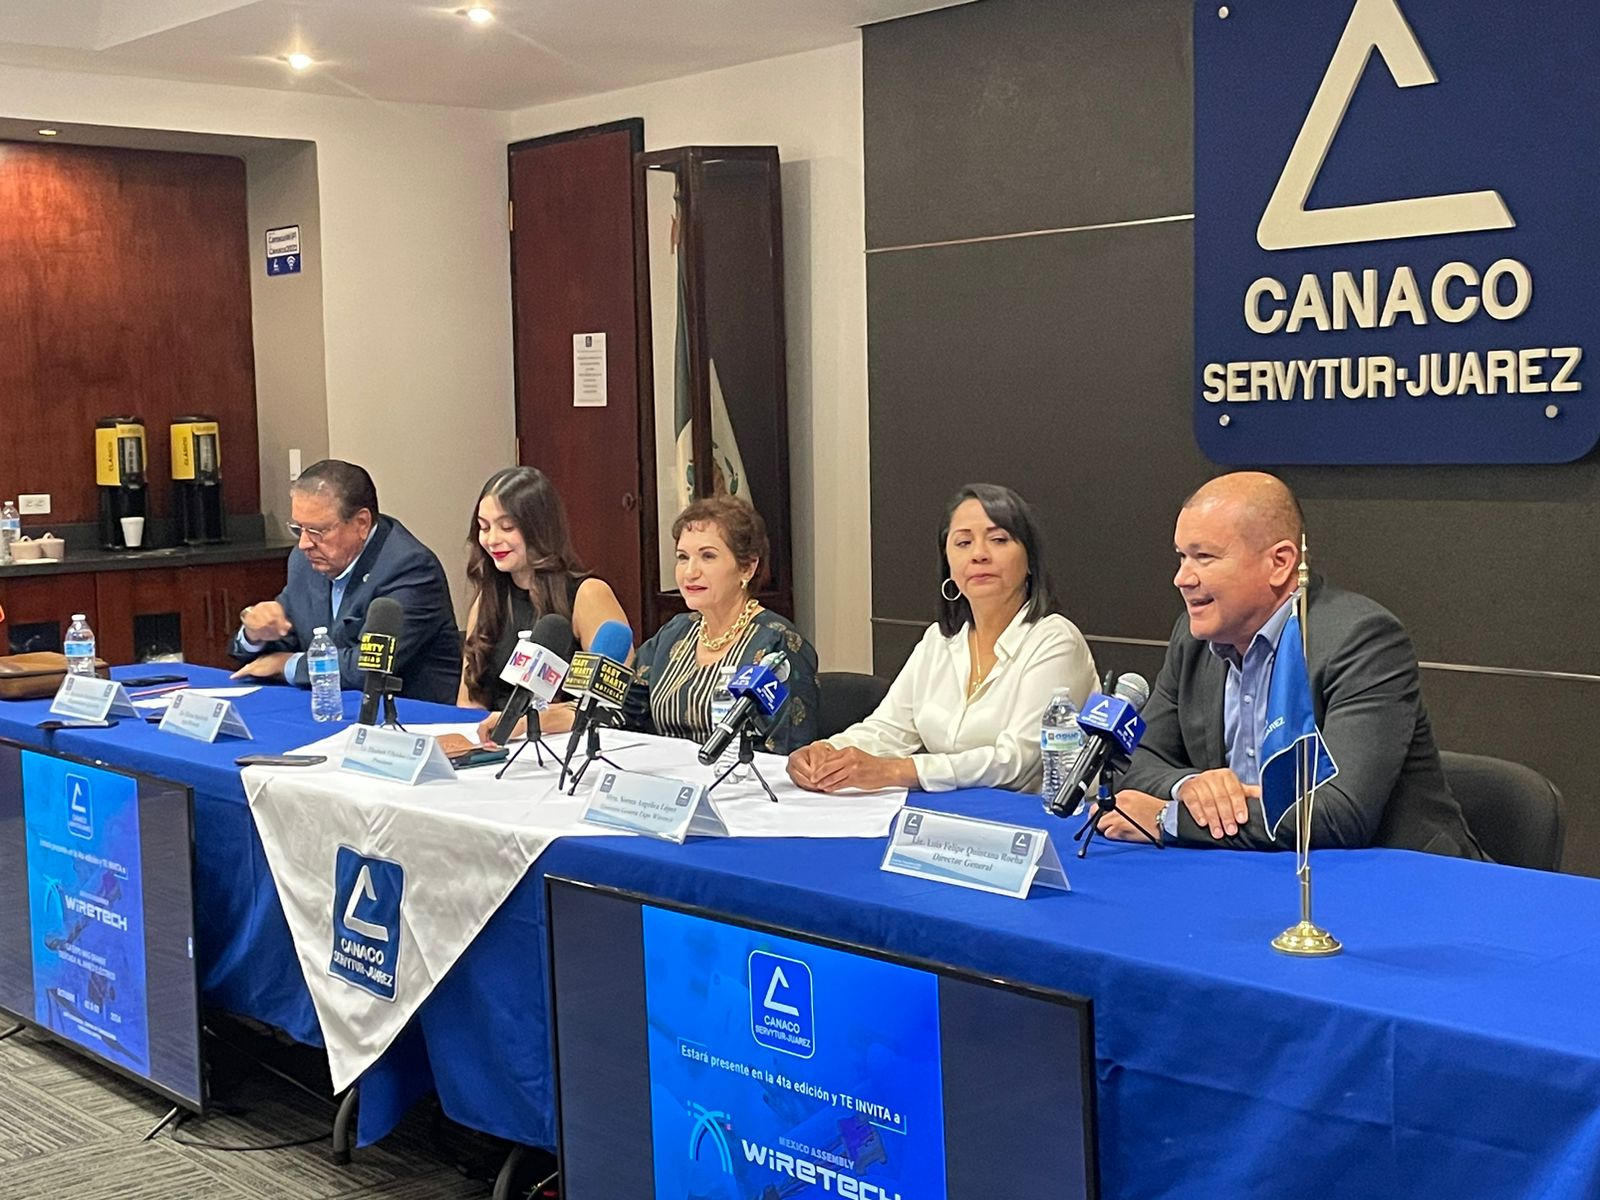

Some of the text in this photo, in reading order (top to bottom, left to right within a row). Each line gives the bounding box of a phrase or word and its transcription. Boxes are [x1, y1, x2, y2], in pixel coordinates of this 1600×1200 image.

[1244, 258, 1533, 334] CANACO
[509, 651, 532, 667] NET
[601, 663, 621, 678] GABY
[537, 662, 562, 685] NET
[927, 838, 942, 849] Luis
[943, 841, 965, 855] Felipe
[966, 846, 999, 861] Quintana
[932, 852, 962, 866] Director
[963, 859, 993, 872] General
[340, 937, 385, 965] CANACO
[764, 1015, 800, 1034] CANACO
[681, 1044, 901, 1125] Estará presente en la 4ta edición y TE INVITA a
[811, 1147, 855, 1170] ASSEMBLY
